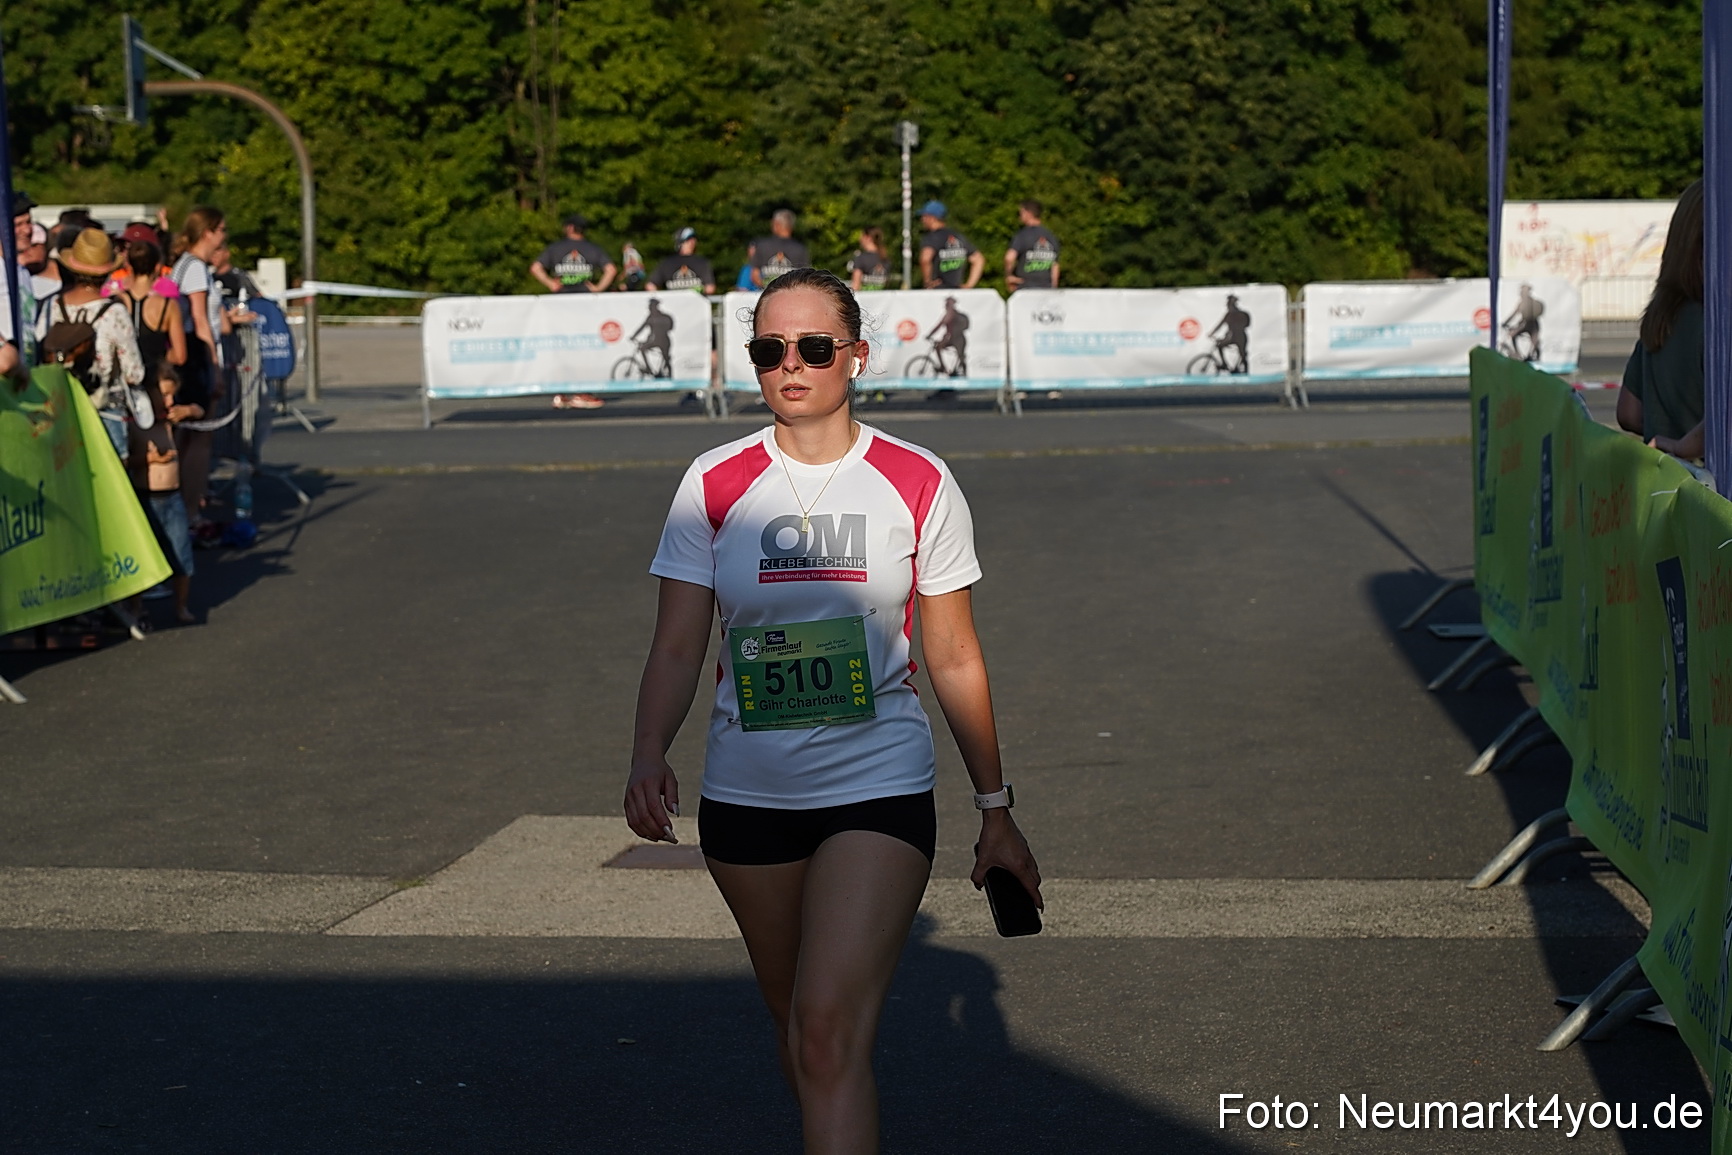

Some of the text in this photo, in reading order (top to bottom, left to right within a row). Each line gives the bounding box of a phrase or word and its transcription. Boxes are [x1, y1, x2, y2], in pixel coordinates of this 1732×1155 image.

[0, 479, 45, 553] lauf
[761, 514, 867, 560] OM
[762, 557, 866, 570] KLEBE TECHNIK
[775, 572, 811, 580] Verbindung
[838, 573, 866, 581] Leistung
[760, 641, 802, 655] Firmenlauf
[777, 649, 803, 658] neumarkt
[764, 656, 833, 696] 510
[849, 658, 867, 707] 2022
[741, 675, 755, 711] RUN
[759, 694, 847, 712] Gihr Charlotte
